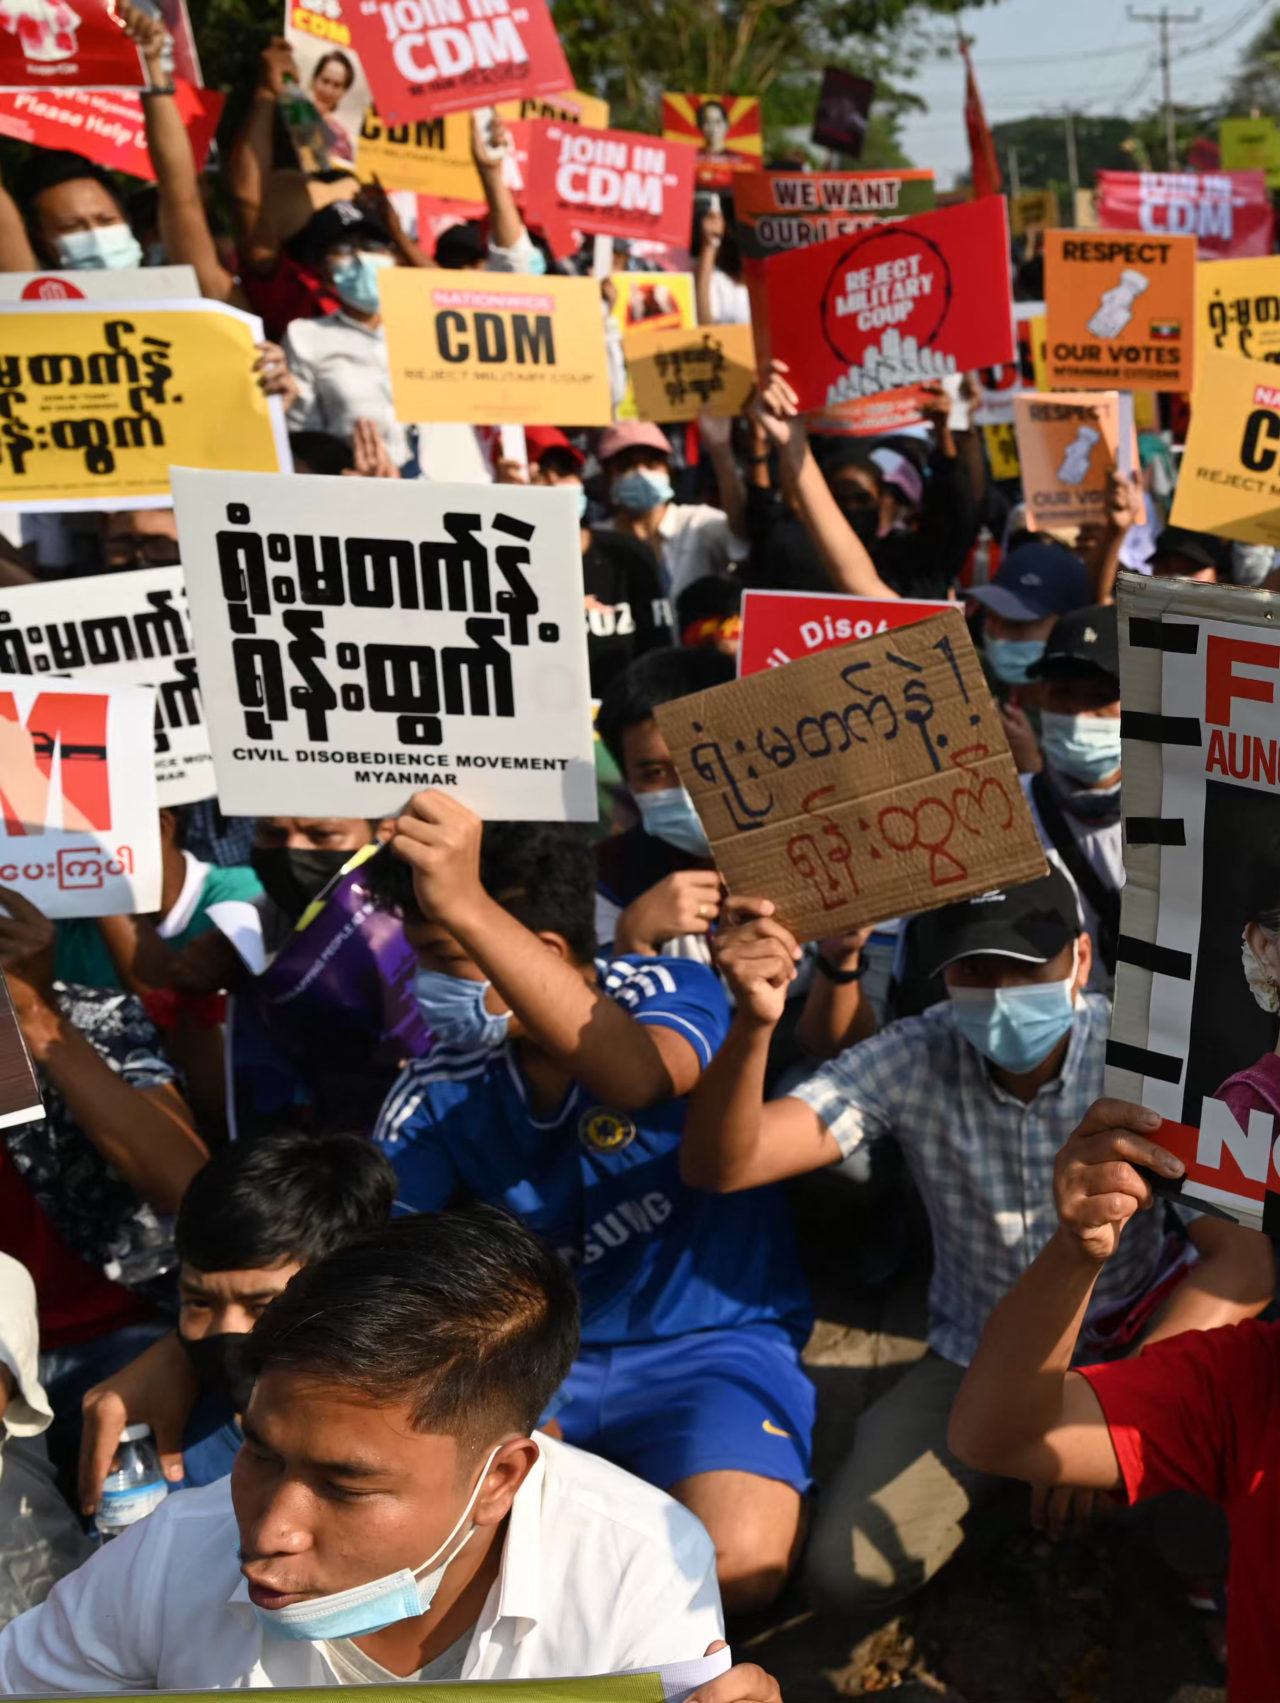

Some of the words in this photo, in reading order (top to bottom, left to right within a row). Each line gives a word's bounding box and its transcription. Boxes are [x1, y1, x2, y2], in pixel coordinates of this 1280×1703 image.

[85, 113, 133, 147] Help
[631, 146, 667, 174] IN
[773, 179, 814, 208] WE
[821, 177, 899, 209] WANT
[1062, 241, 1172, 264] RESPECT
[845, 253, 922, 292] REJECT
[432, 289, 554, 311] NATIONWIDE
[835, 273, 934, 318] MILITARY
[857, 299, 915, 332] COUP
[435, 310, 557, 366] CDM
[1054, 343, 1102, 363] OUR
[1108, 346, 1181, 365] VOTES
[1196, 466, 1265, 494] REJECT
[232, 747, 289, 763] CIVIL
[296, 749, 449, 768] DISOBEDIENCE
[455, 755, 569, 772] MOVEMENT
[354, 771, 458, 787] MYANMAR
